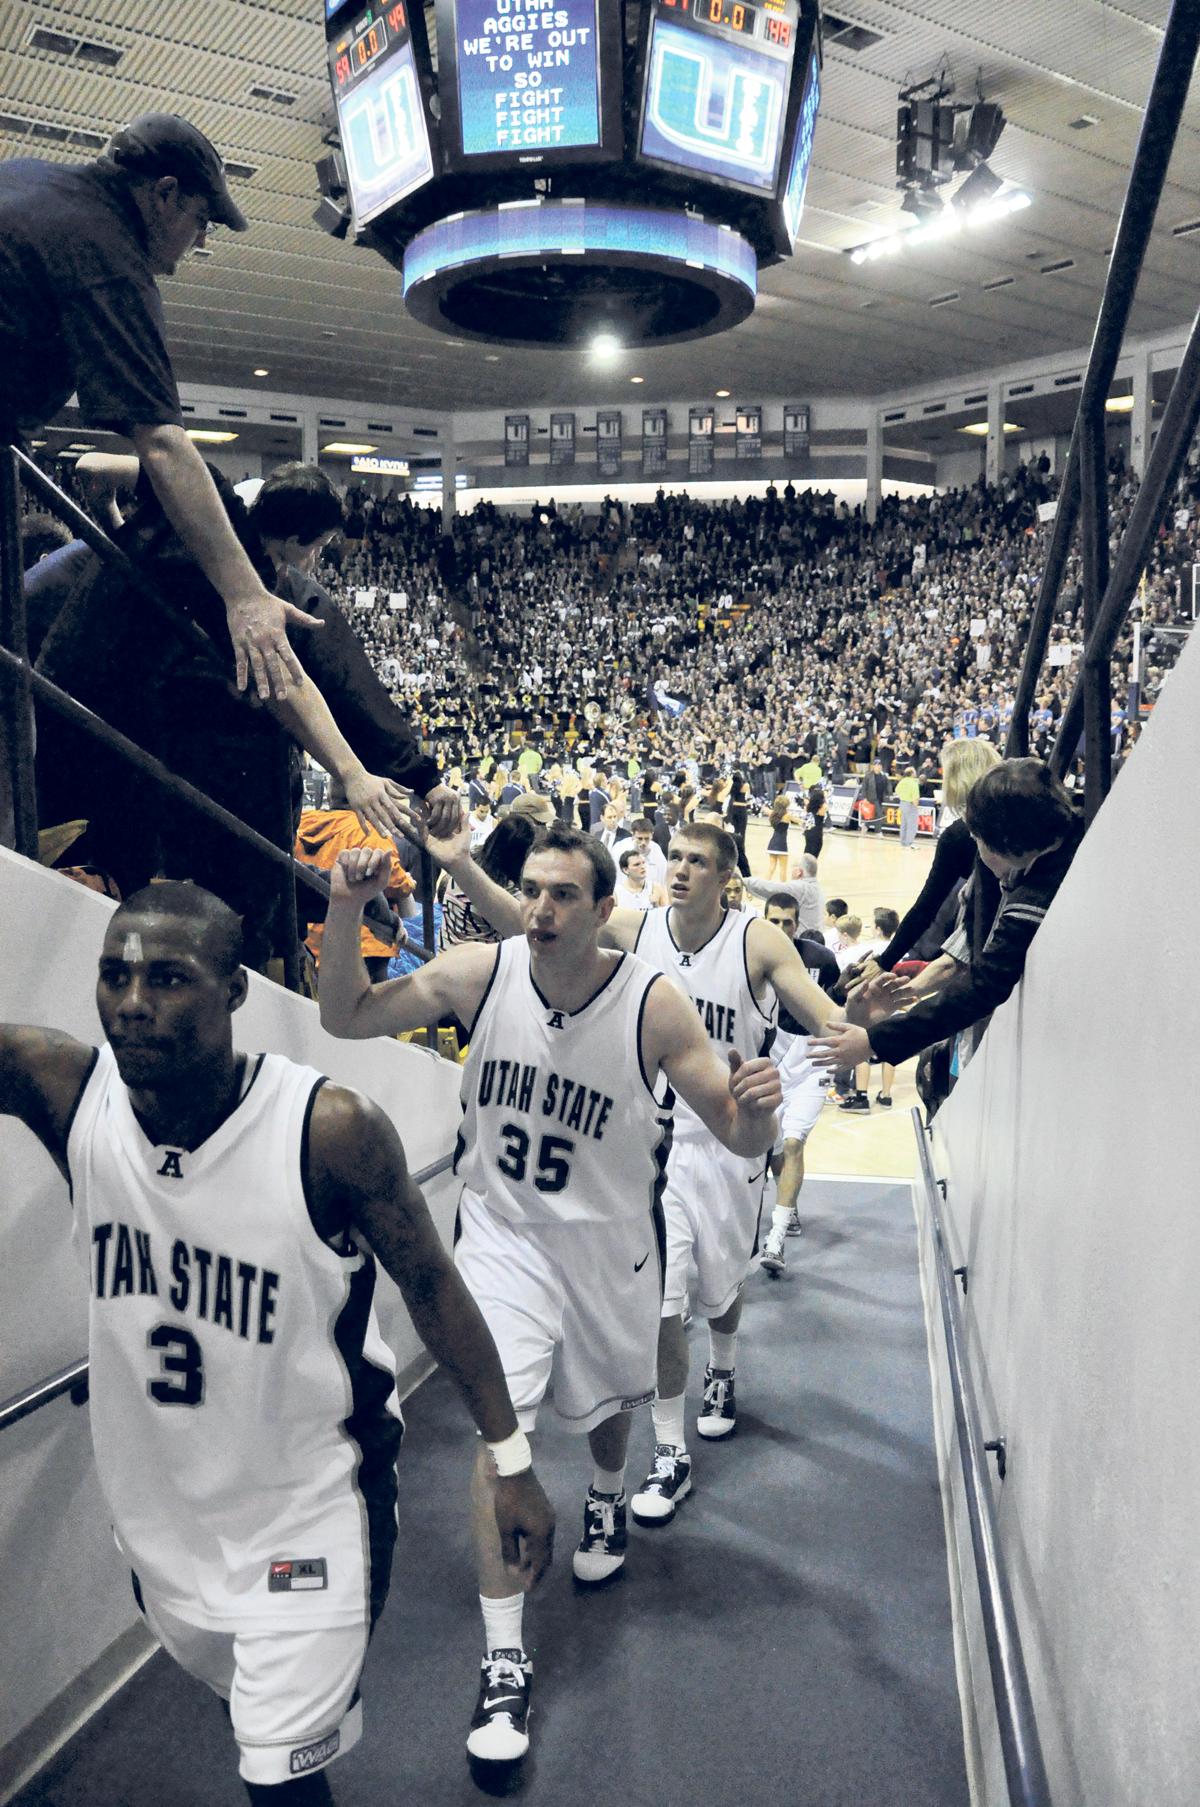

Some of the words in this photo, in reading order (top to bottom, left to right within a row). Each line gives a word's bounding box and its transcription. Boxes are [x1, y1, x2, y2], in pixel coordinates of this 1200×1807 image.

[483, 10, 569, 35] AGGIES
[463, 33, 534, 55] WE'RE
[548, 28, 590, 48] OUT
[486, 54, 513, 72] TO
[527, 49, 570, 68] WIN
[514, 71, 542, 88] SO
[495, 88, 563, 109] FIGHT
[496, 107, 564, 127] FIGHT
[496, 125, 565, 146] FIGHT
[679, 954, 692, 967] A
[547, 1011, 564, 1030] A
[689, 995, 736, 1044] TATE
[478, 1060, 538, 1114] UTAH
[542, 1073, 614, 1141] STATE
[157, 1150, 184, 1178] A
[497, 1121, 576, 1195] 35
[169, 1237, 280, 1345] STATE
[146, 1321, 206, 1409] 3
